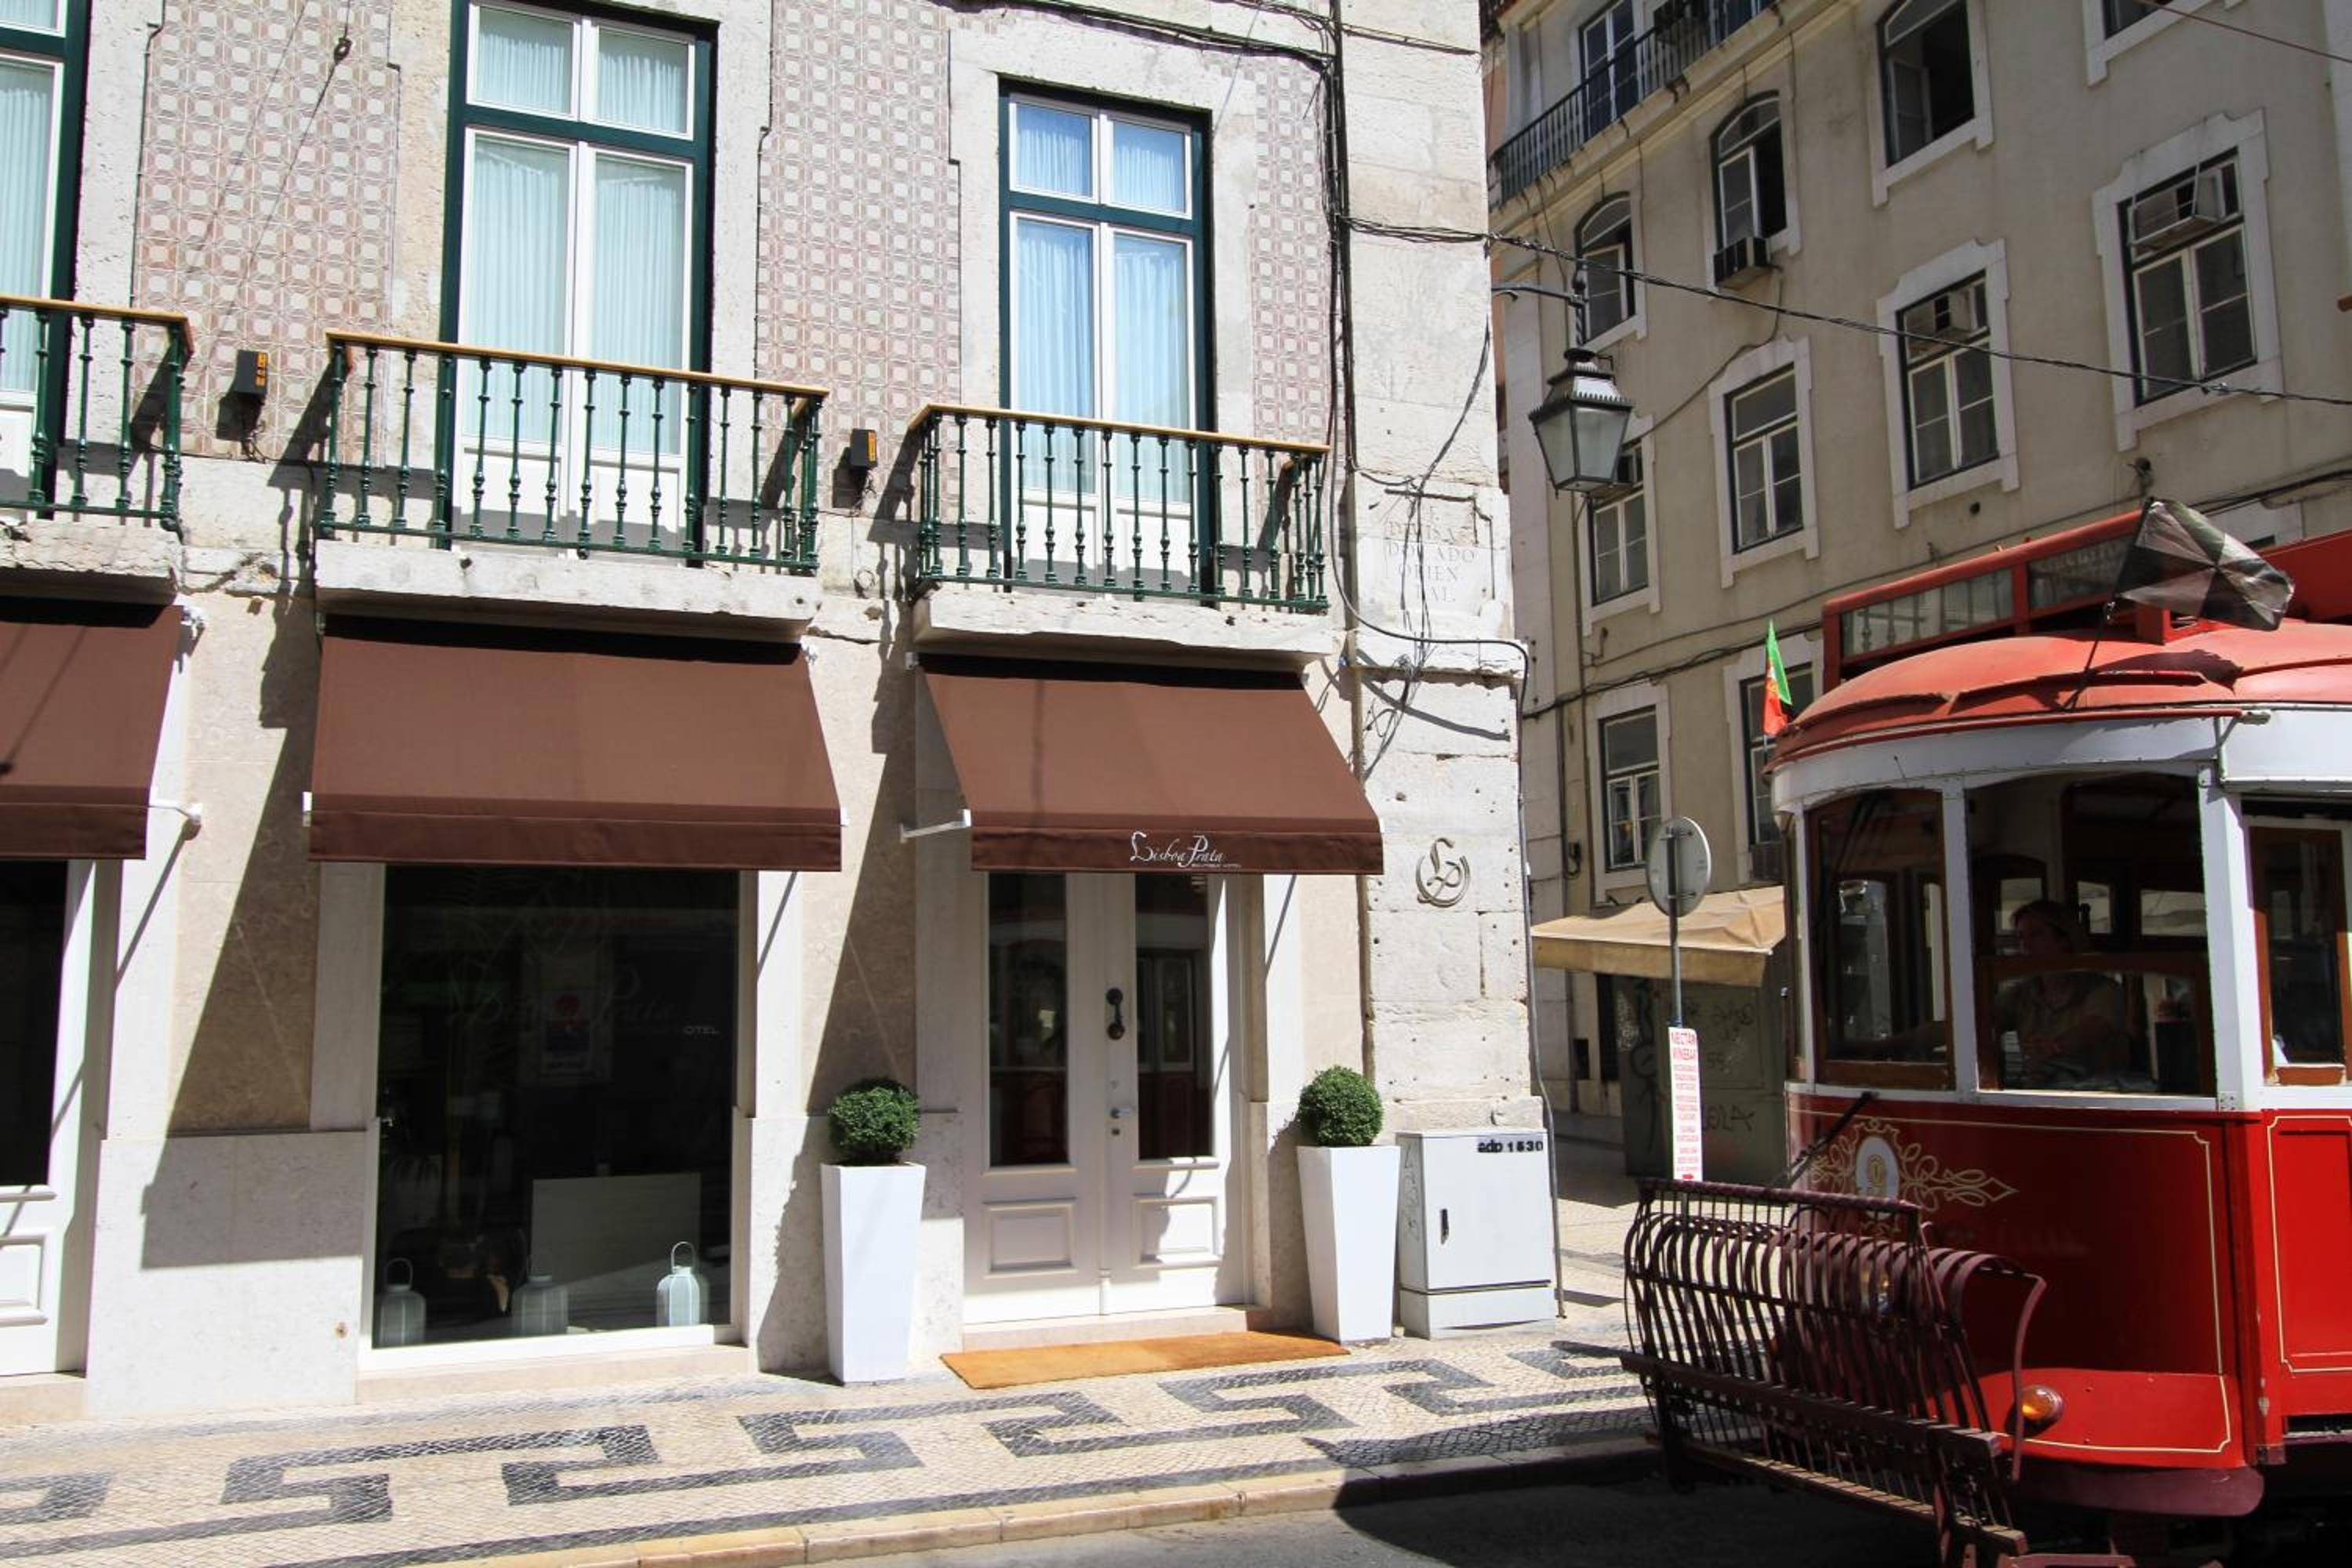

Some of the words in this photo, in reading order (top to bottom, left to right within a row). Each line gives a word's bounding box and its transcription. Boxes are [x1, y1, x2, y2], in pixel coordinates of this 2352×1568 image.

[1422, 545, 1475, 564] ADO
[1130, 831, 1186, 862] Lisboa
[1178, 834, 1224, 867] Prata
[1478, 1139, 1503, 1153] edp
